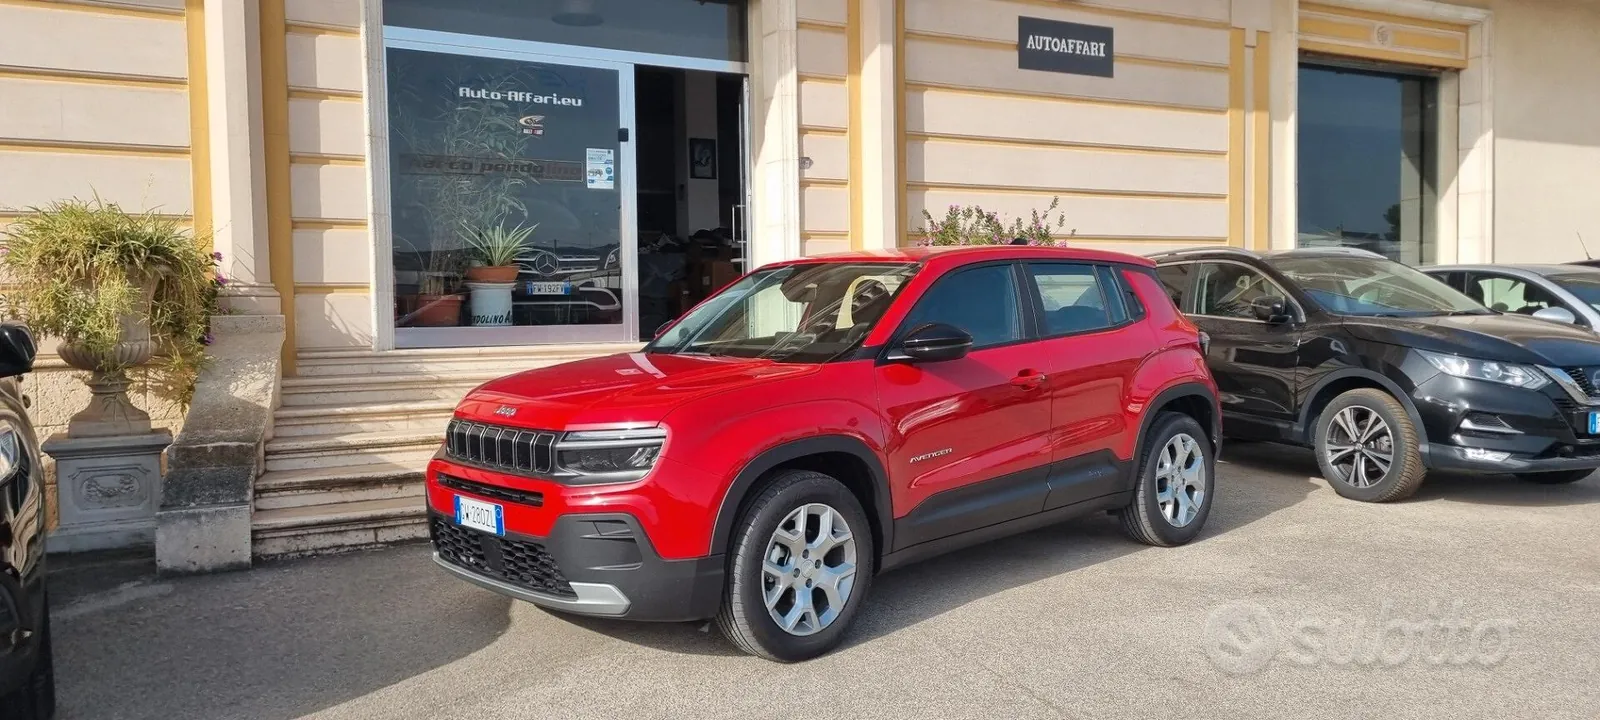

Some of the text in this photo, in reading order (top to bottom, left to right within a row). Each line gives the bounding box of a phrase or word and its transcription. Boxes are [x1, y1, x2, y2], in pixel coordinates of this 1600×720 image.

[1026, 35, 1105, 57] AUTOAFFARI
[459, 87, 582, 107] Auto-Affari.eu
[910, 448, 952, 463] AVENGER
